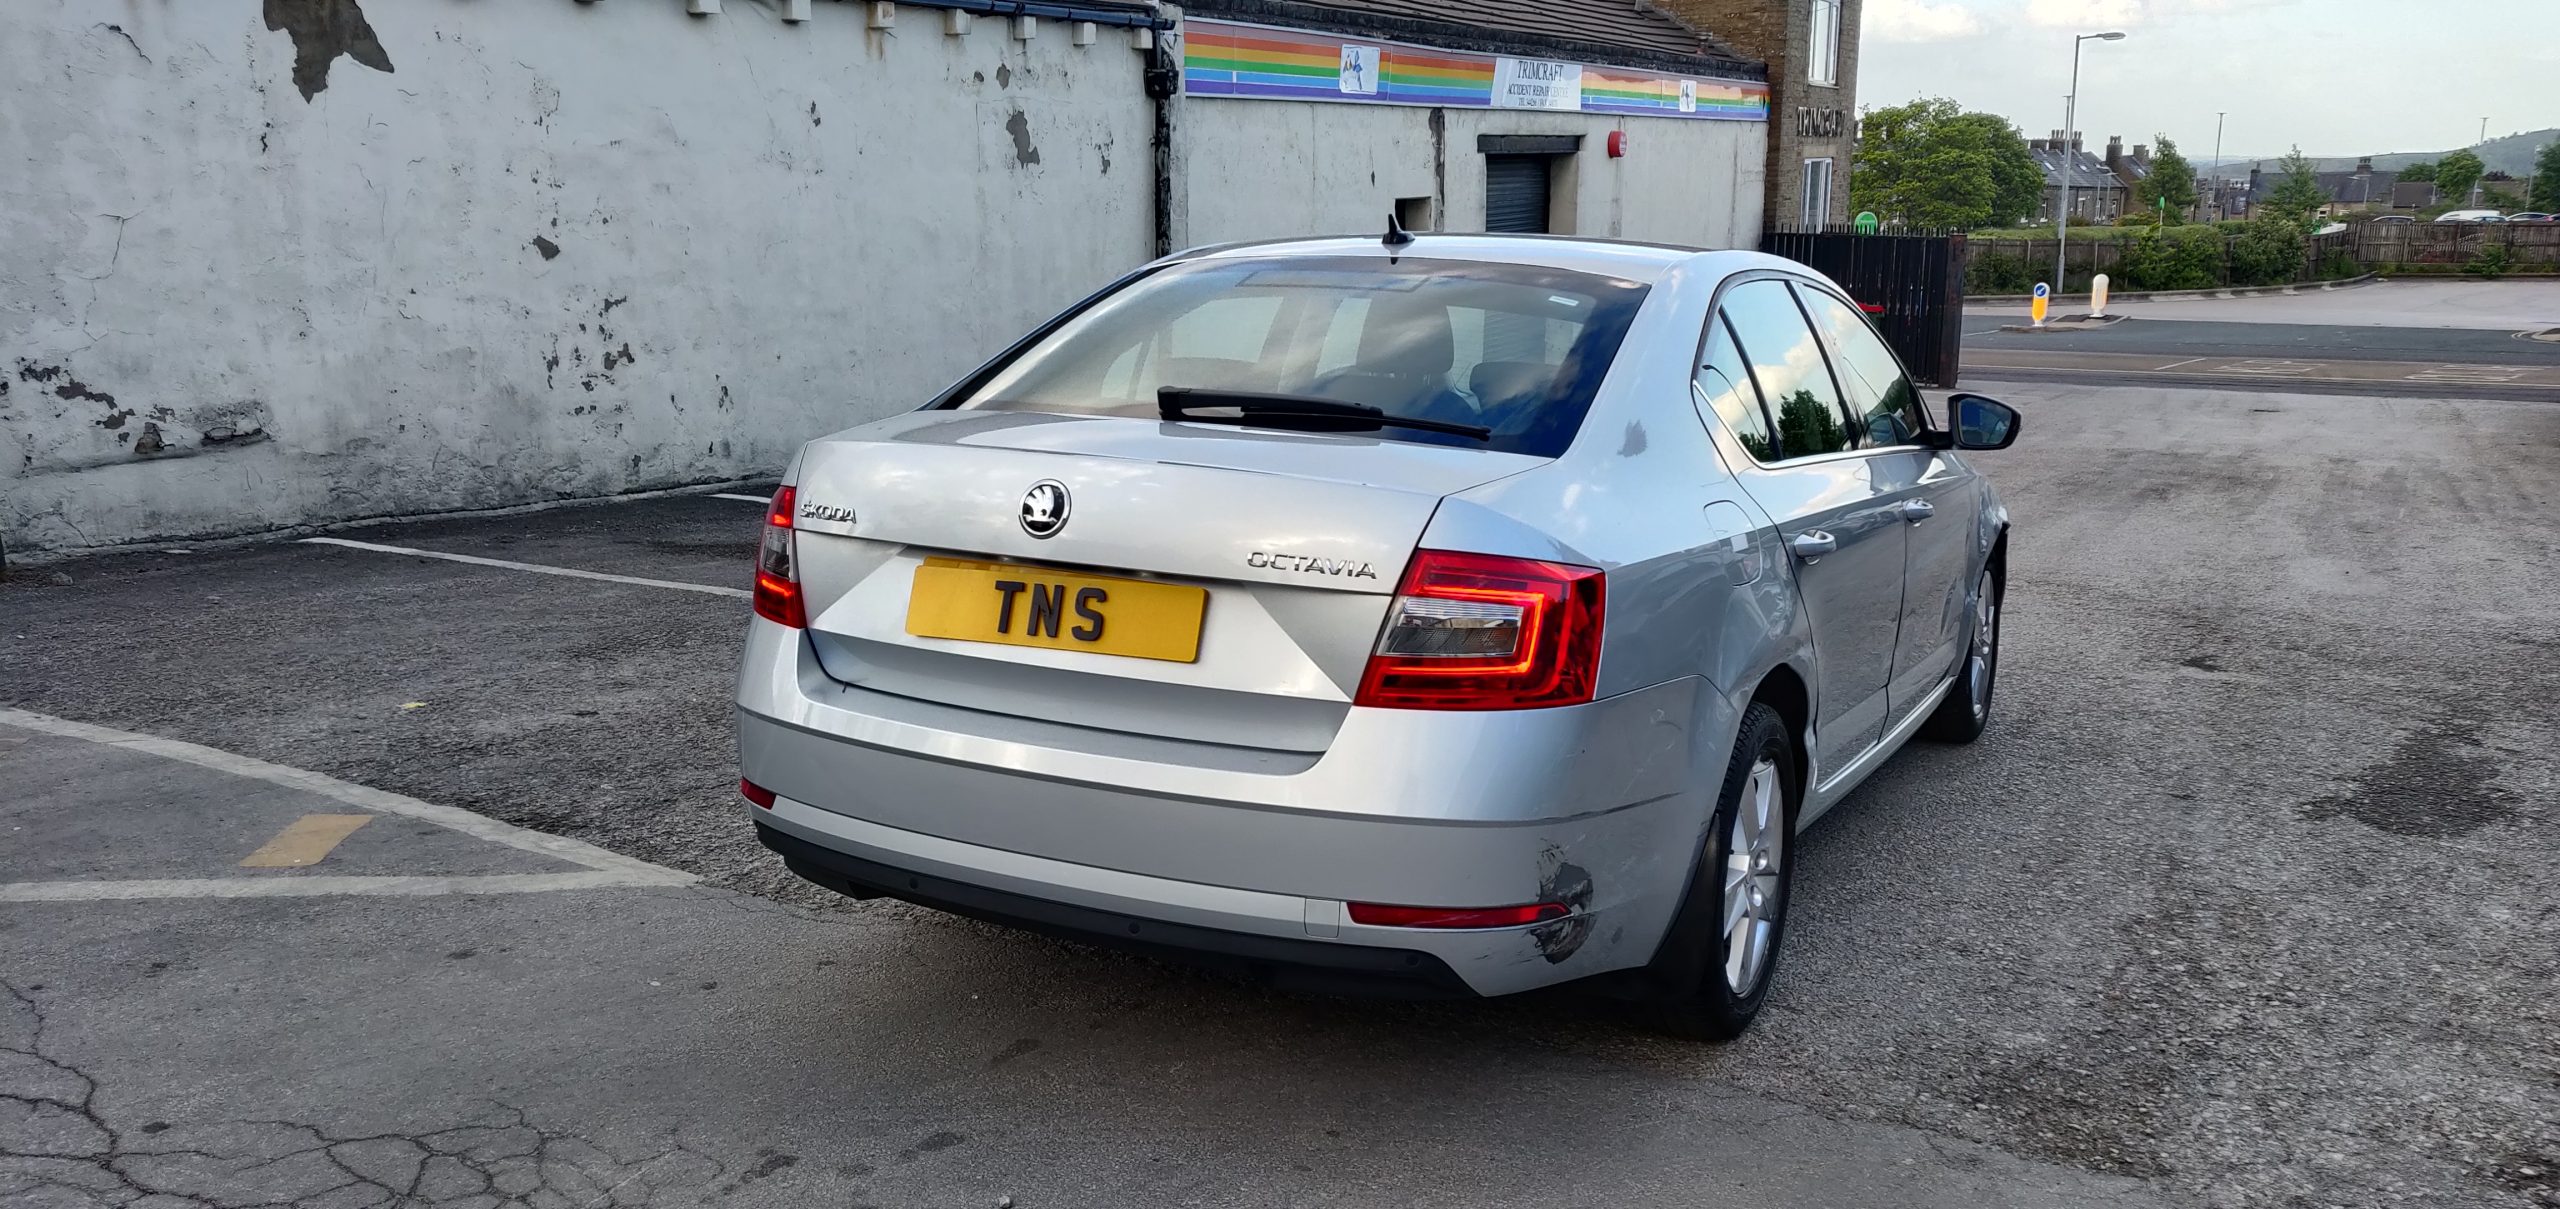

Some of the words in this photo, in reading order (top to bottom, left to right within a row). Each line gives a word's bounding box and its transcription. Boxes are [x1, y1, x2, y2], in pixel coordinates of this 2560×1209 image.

[1517, 60, 1564, 81] TRIMCRAFT
[1507, 83, 1532, 96] ACCIDENT
[1533, 85, 1549, 97] REPAIR
[1247, 552, 1377, 580] OCTAVIA
[995, 580, 1107, 641] TNS
